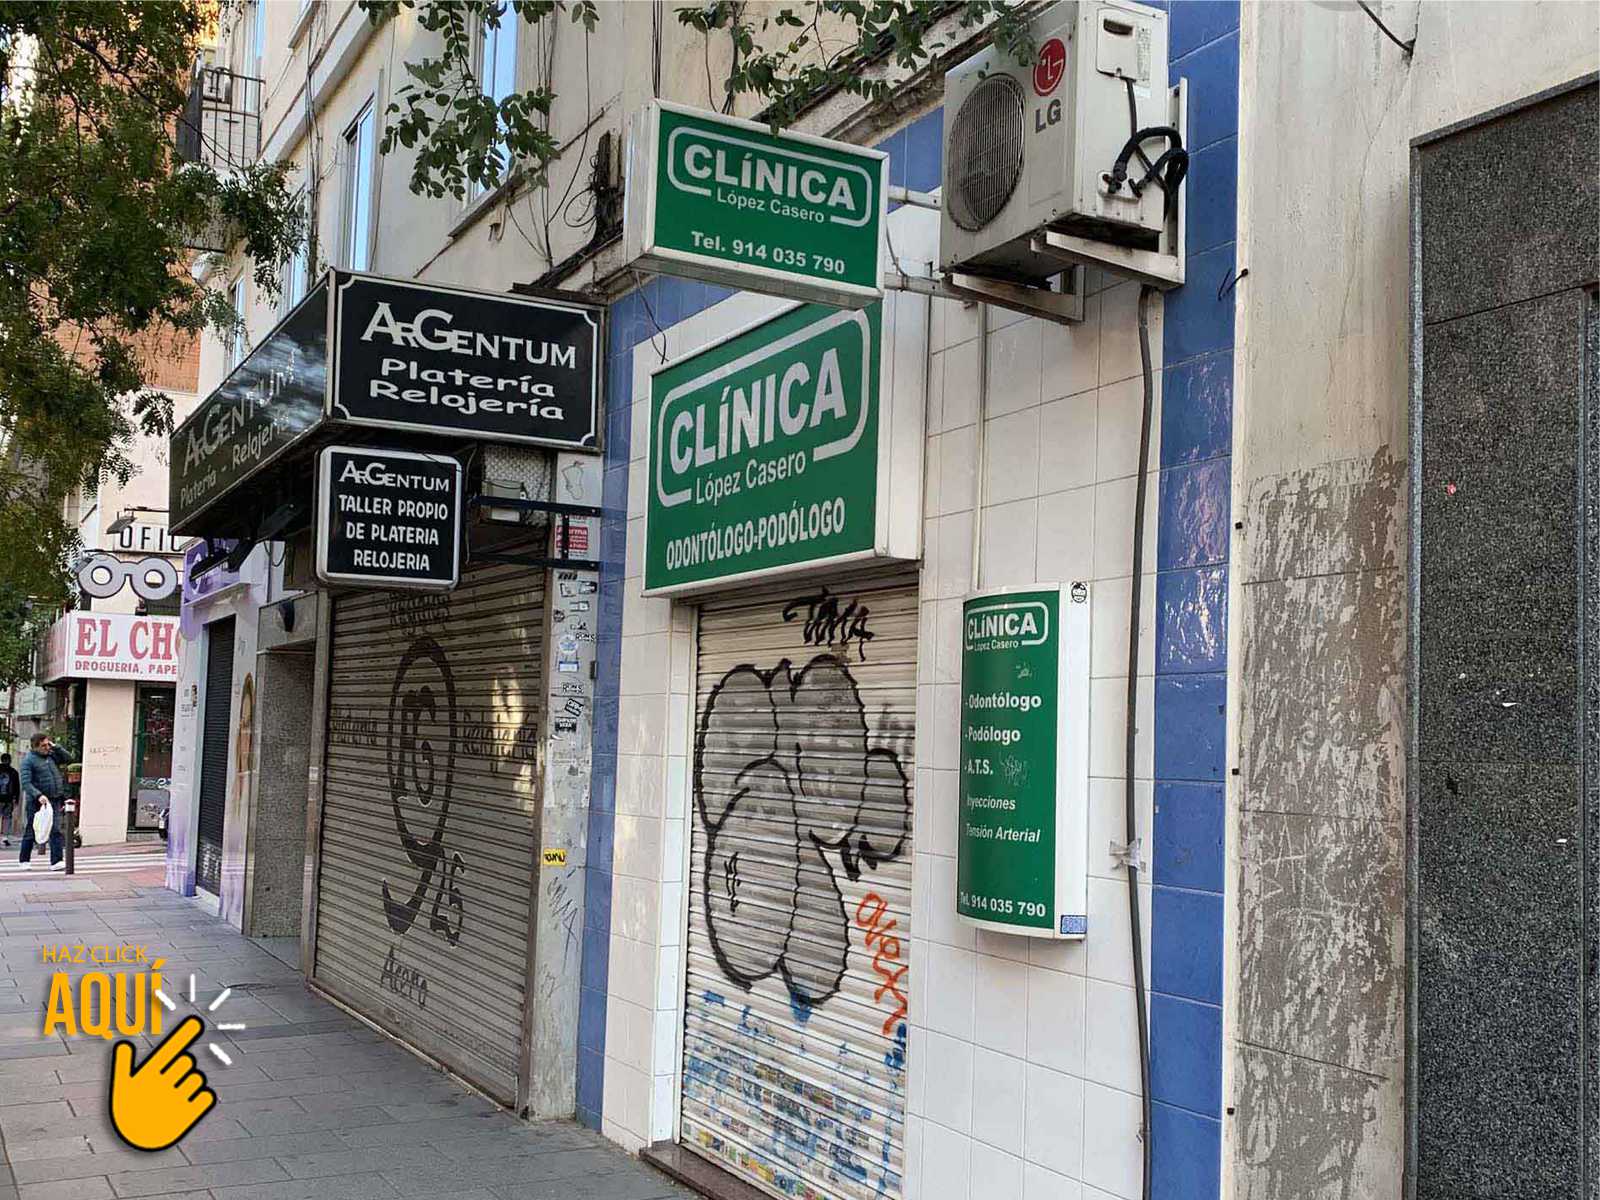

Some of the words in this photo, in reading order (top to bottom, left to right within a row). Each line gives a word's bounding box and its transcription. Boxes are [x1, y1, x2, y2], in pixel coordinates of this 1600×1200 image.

[1035, 99, 1062, 133] LG
[684, 144, 856, 211] CLÍNICA
[716, 188, 766, 211] López
[770, 199, 825, 223] Casero
[691, 231, 726, 251] Tel.
[732, 239, 768, 260] 914
[772, 247, 807, 267] 035
[813, 255, 845, 274] 790
[381, 358, 555, 398] Platería
[370, 379, 564, 420] Relojería
[670, 348, 846, 474] CLÍNICA
[696, 472, 741, 505] López
[746, 450, 806, 488] Casero
[339, 494, 392, 516] TALLER
[398, 500, 448, 520] PROPIO
[346, 521, 365, 540] DE
[371, 523, 439, 546] PLATERIA
[666, 497, 846, 570] ODONTÓLOGO-PODÓLOGO
[353, 549, 430, 571] RELOJERIA
[75, 618, 118, 658] EL
[968, 612, 1038, 640] CLÍNICA
[991, 639, 1019, 650] Casero
[966, 823, 993, 839] Tensión
[995, 826, 1041, 843] Arterial
[971, 895, 988, 911] 914
[990, 898, 1014, 914] 035
[1017, 901, 1047, 918] 790
